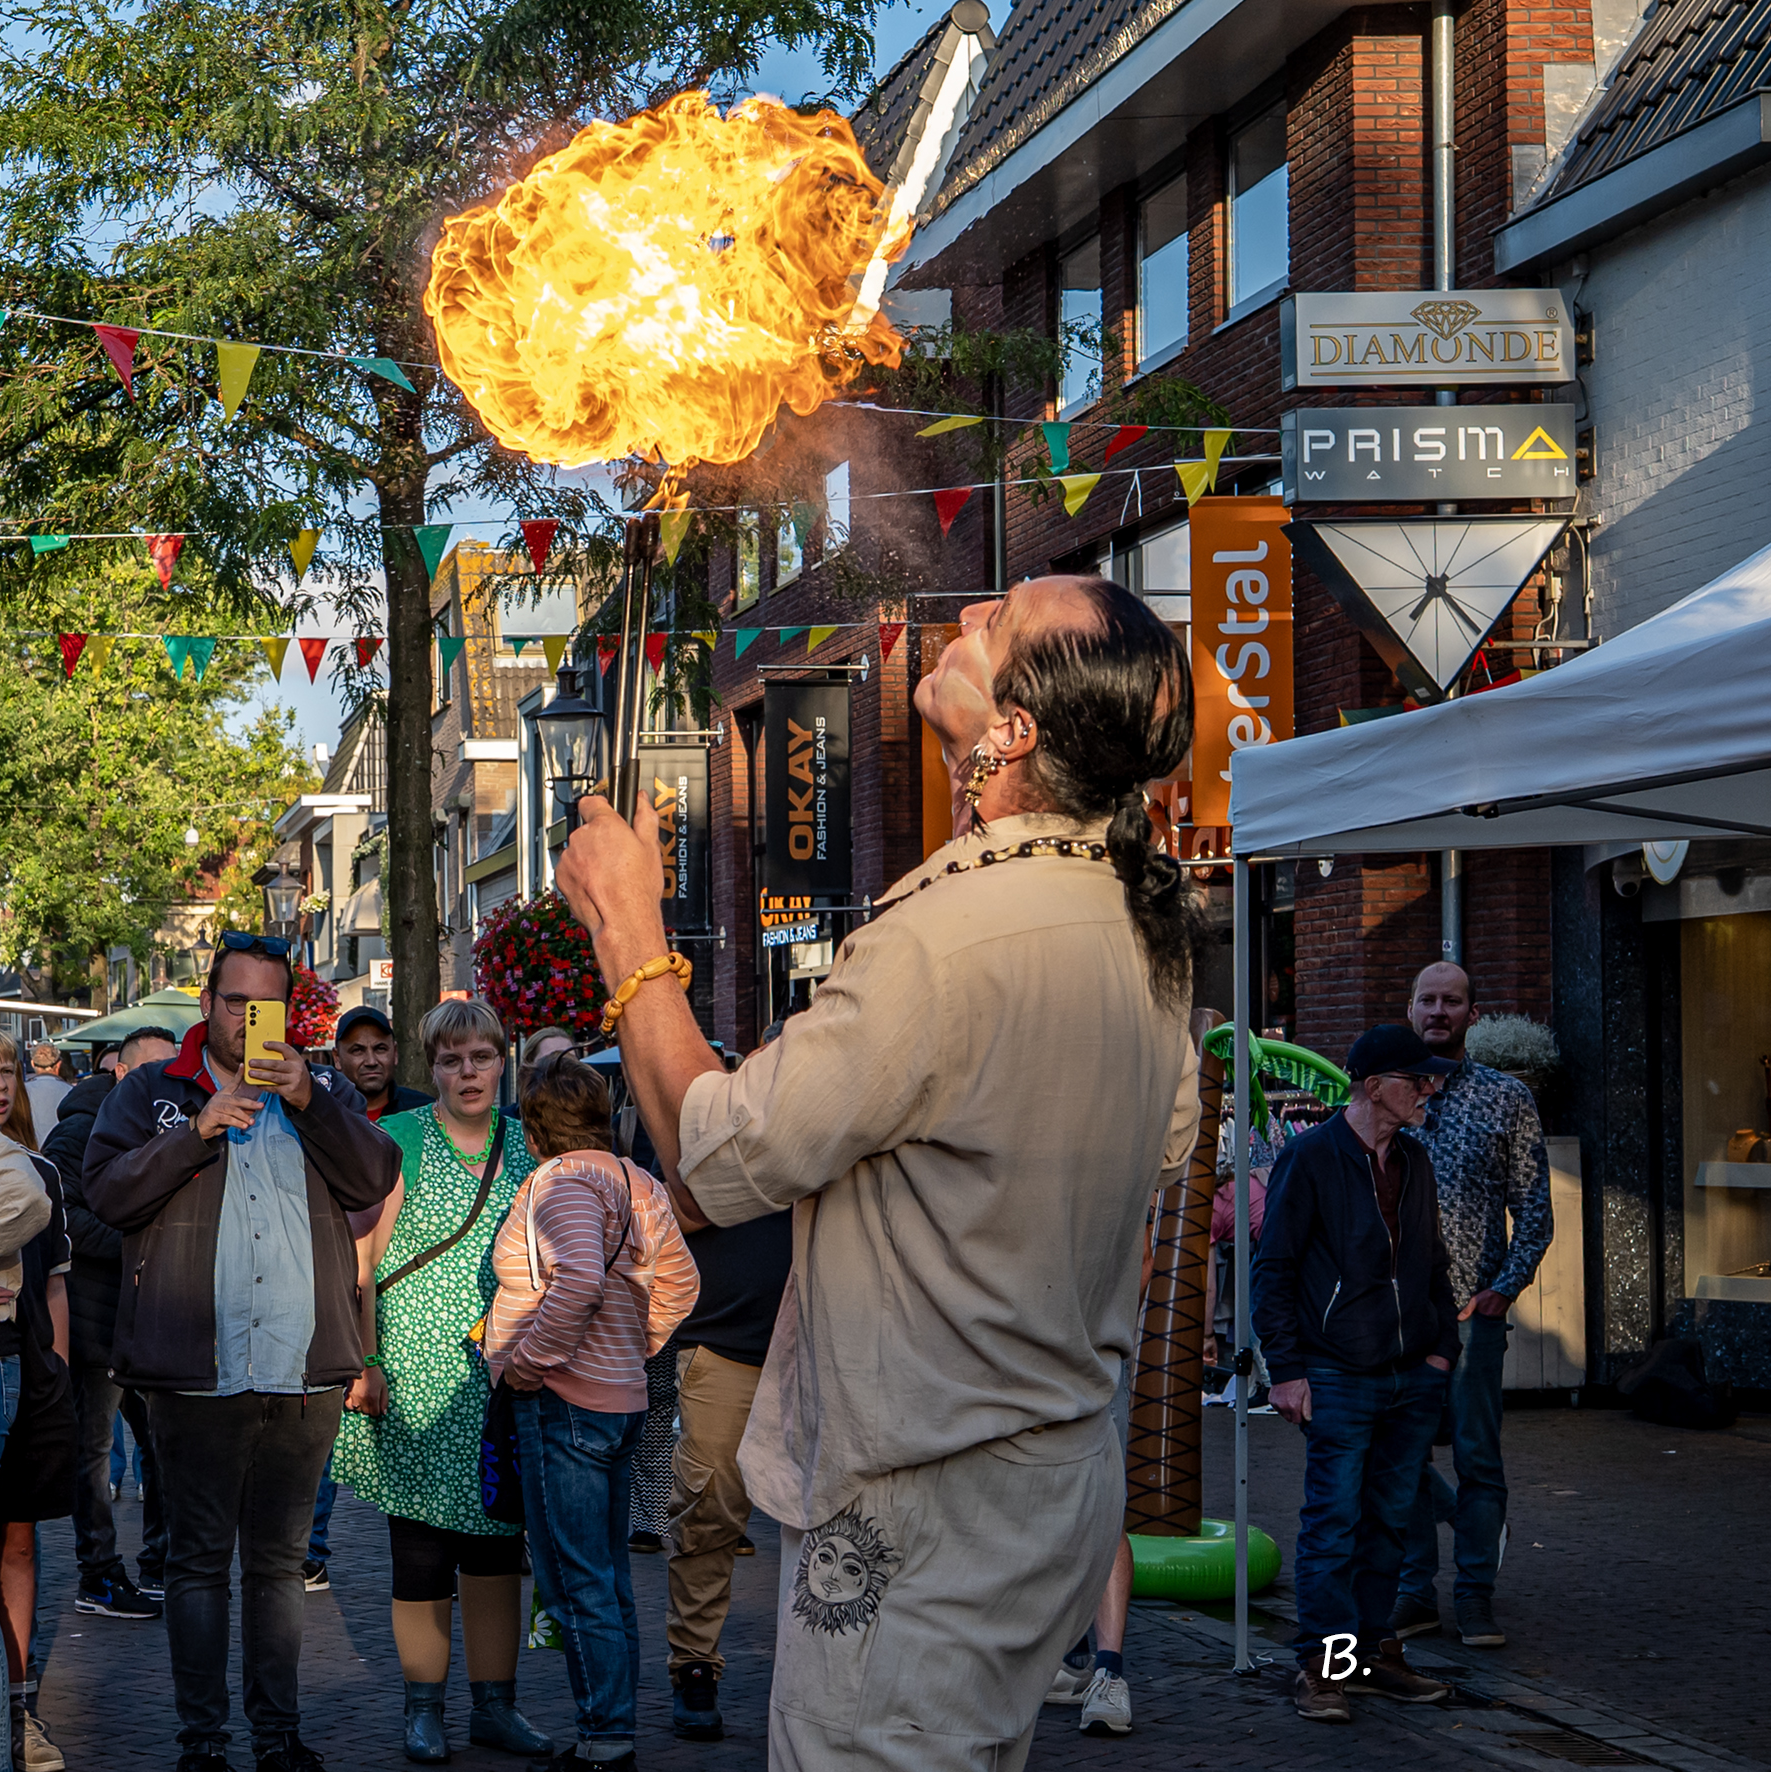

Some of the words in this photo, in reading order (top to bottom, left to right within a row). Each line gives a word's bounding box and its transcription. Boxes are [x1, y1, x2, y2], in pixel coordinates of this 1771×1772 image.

[1309, 330, 1560, 367] DIAMONDE
[1303, 425, 1569, 463] PRISMA
[1304, 466, 1570, 481] WATCH
[1212, 541, 1272, 782] erStal
[815, 716, 826, 770] JEANS
[678, 775, 688, 822] JEANS
[787, 717, 814, 861] OKAY
[816, 773, 827, 785] &
[654, 776, 677, 899] OKAY
[678, 824, 687, 835] &
[816, 789, 827, 861] FASHION
[678, 838, 687, 899] FASHION
[795, 924, 817, 942] JEANS
